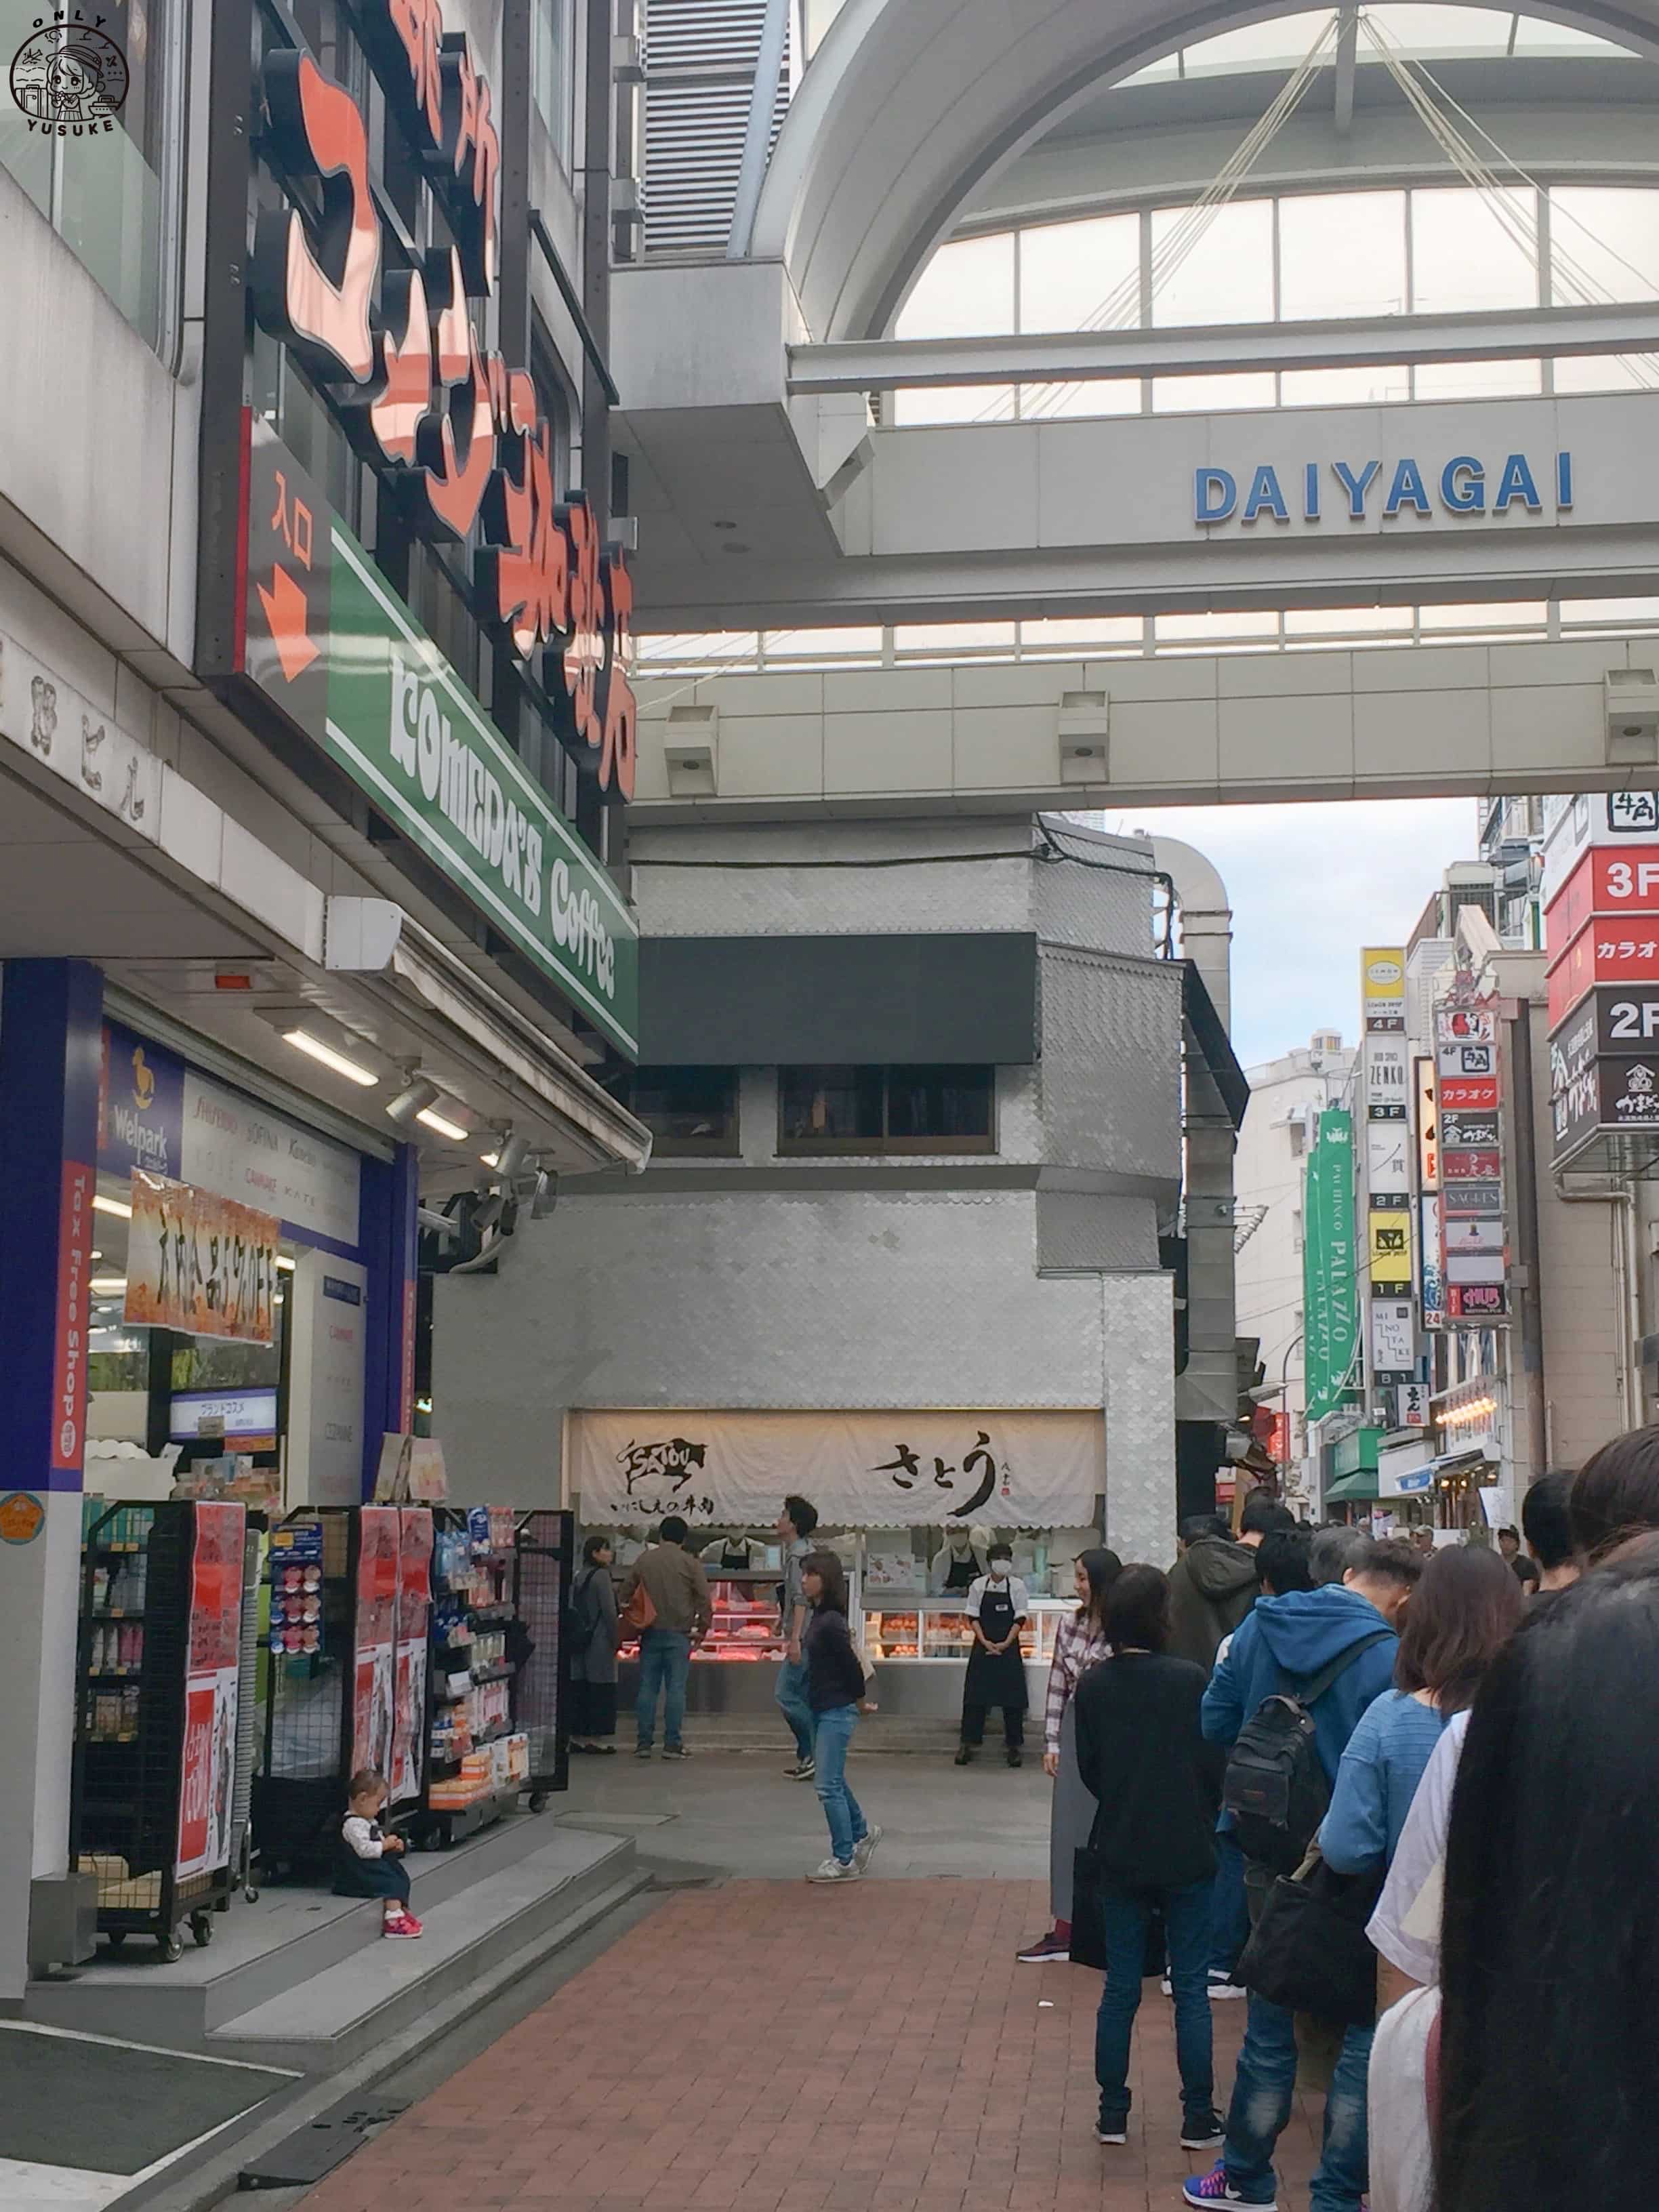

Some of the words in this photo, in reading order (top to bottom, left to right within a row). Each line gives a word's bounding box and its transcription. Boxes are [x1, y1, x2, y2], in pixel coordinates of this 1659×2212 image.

[1195, 452, 1574, 521] DAIYAGAI
[271, 470, 312, 571] 入口
[1614, 794, 1654, 820] 牛角
[1607, 863, 1659, 898] 3F
[550, 858, 615, 1000] Coffee
[1373, 1019, 1398, 1029] 4F
[1610, 1003, 1659, 1038] 2F
[1370, 1065, 1404, 1085] ZENKO
[1374, 1106, 1400, 1118] 3F
[1442, 1089, 1494, 1101] カラオケ
[114, 1104, 168, 1166] Welpark
[1443, 1113, 1459, 1124] 2F
[73, 1176, 85, 1236] Tax
[1376, 1195, 1402, 1206] 2F
[69, 1248, 82, 1322] Free
[1330, 1241, 1351, 1342] PALAZZO
[1378, 1283, 1404, 1294] 1F
[1426, 1313, 1440, 1324] 24
[62, 1329, 79, 1416] Shop
[631, 1441, 691, 1478] SATOU
[869, 1430, 996, 1517] さとう
